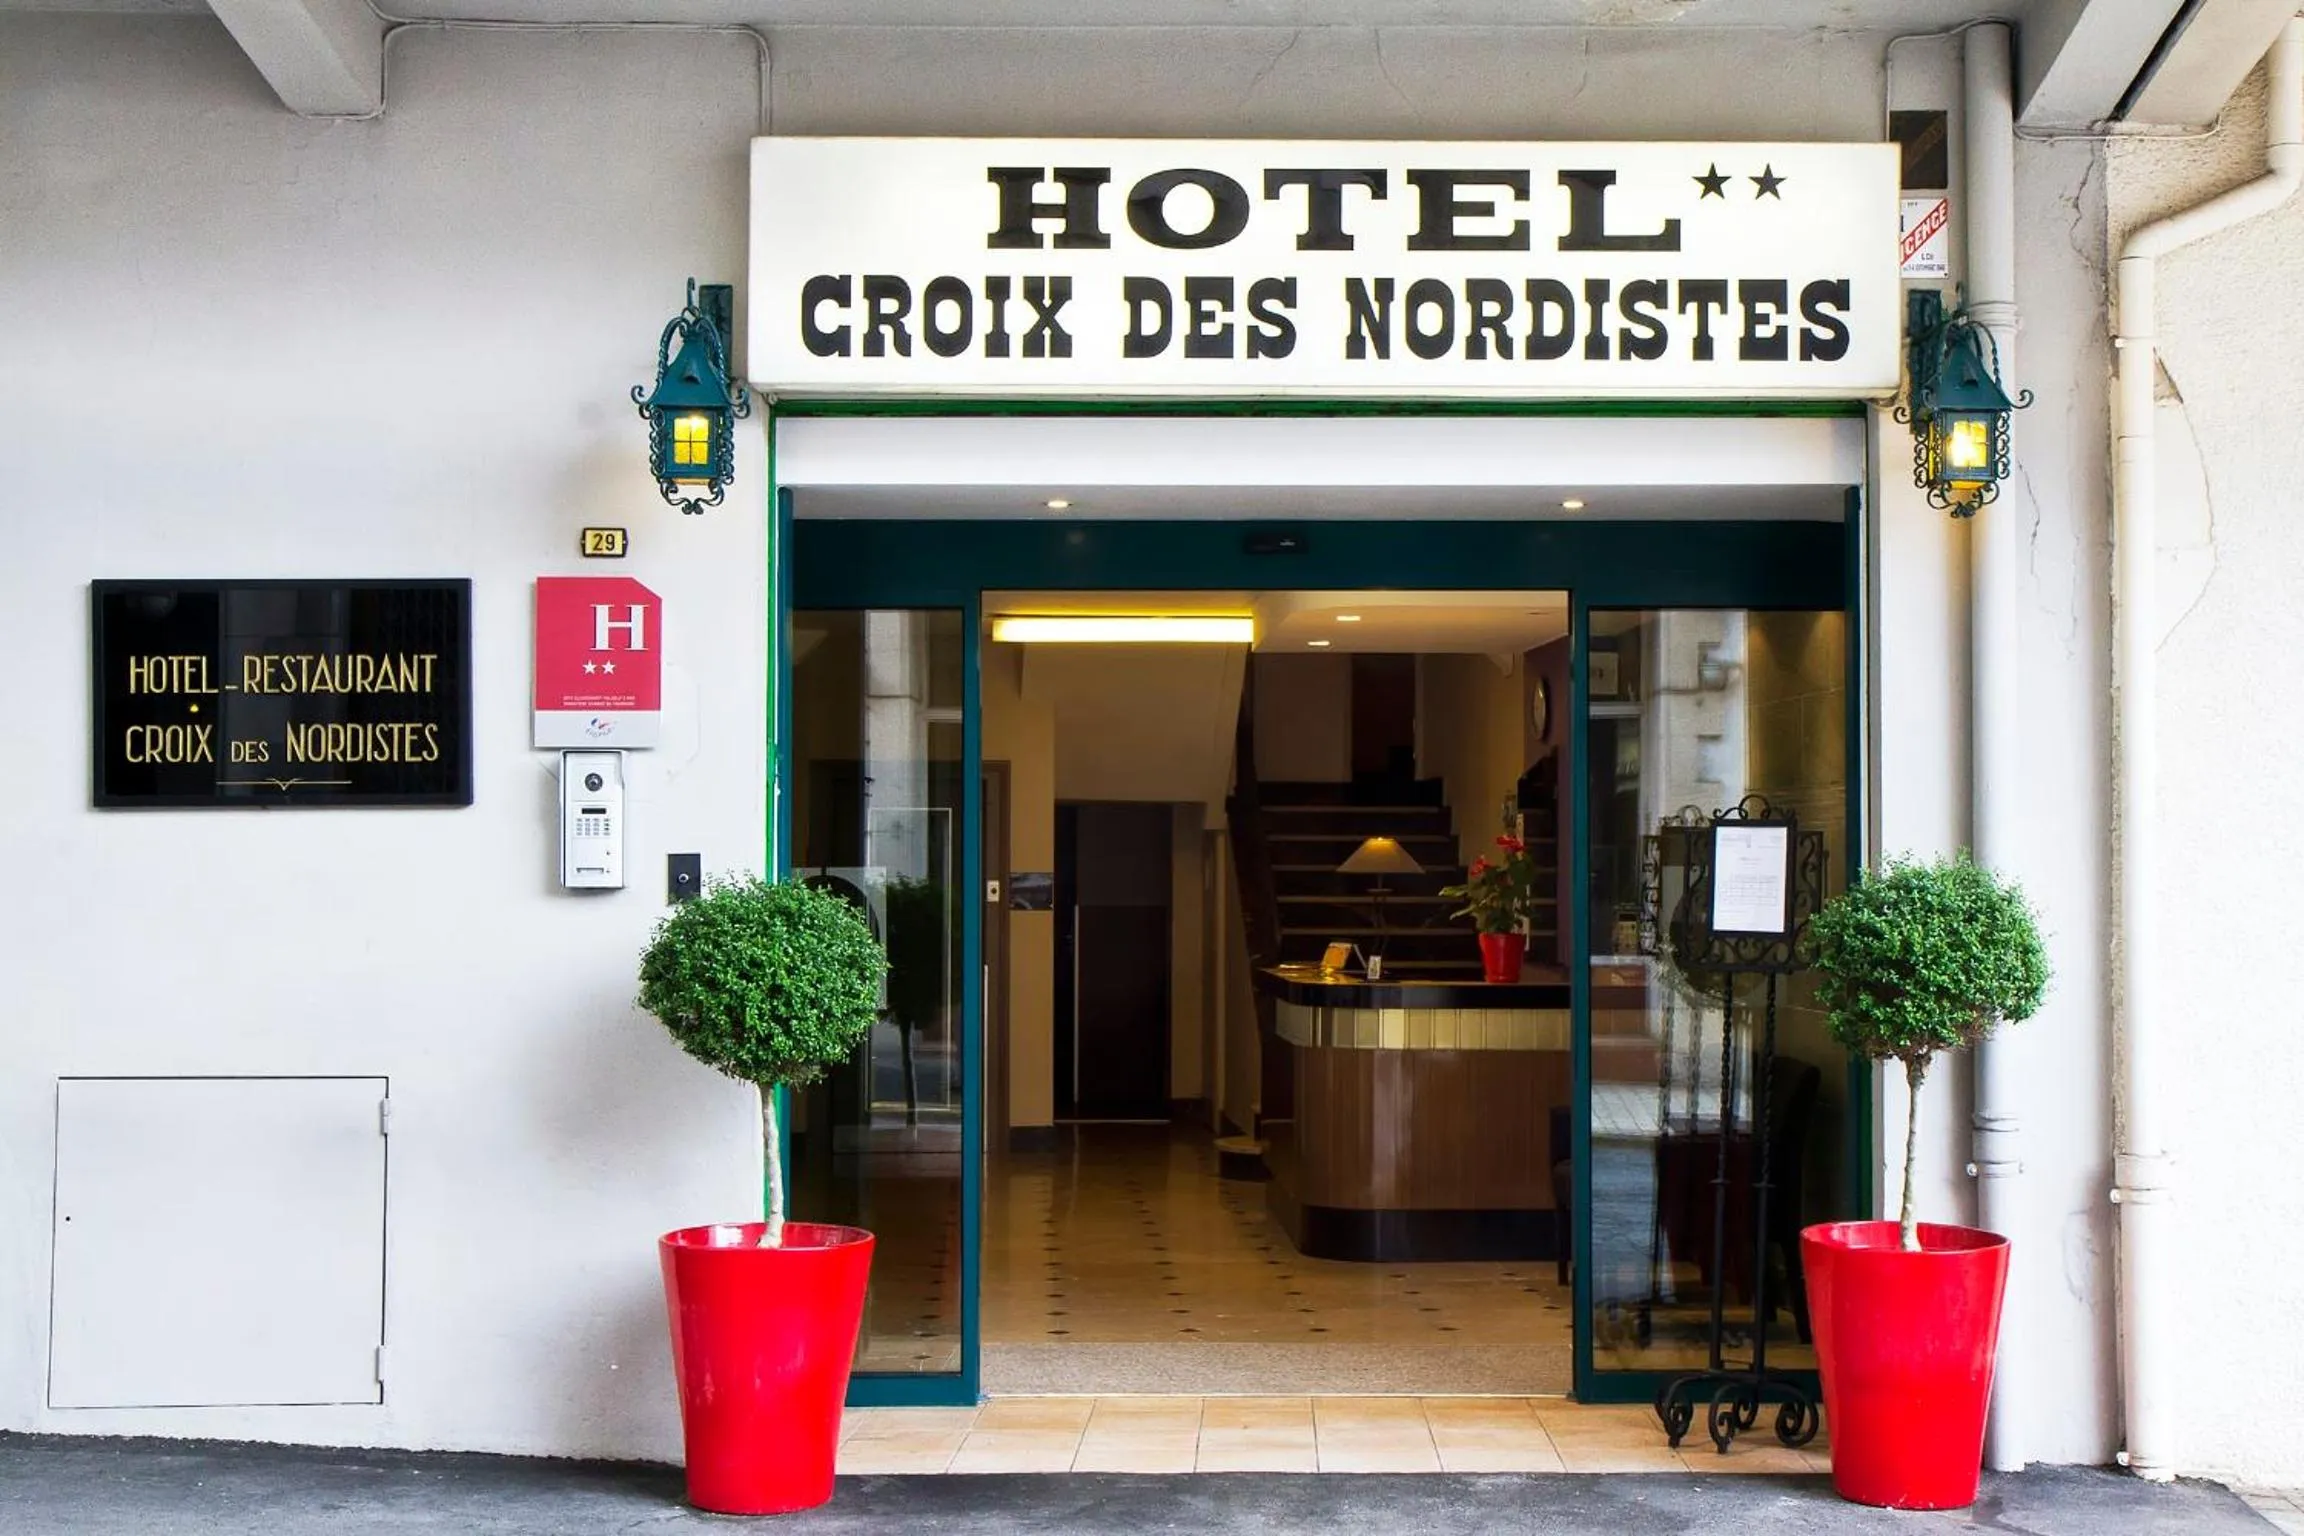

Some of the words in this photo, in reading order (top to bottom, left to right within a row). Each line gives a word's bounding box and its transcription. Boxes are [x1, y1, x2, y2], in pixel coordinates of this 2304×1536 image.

[988, 166, 1681, 252] HOTEL
[1900, 201, 1947, 262] ICENCE
[801, 274, 1073, 358] CROIX
[1123, 276, 1297, 359] DES
[1345, 277, 1850, 362] NORDISTES
[592, 533, 615, 552] 29
[590, 604, 650, 651] H
[125, 724, 214, 763] CROIX
[231, 740, 270, 763] DES
[286, 721, 439, 763] NORDISTES
